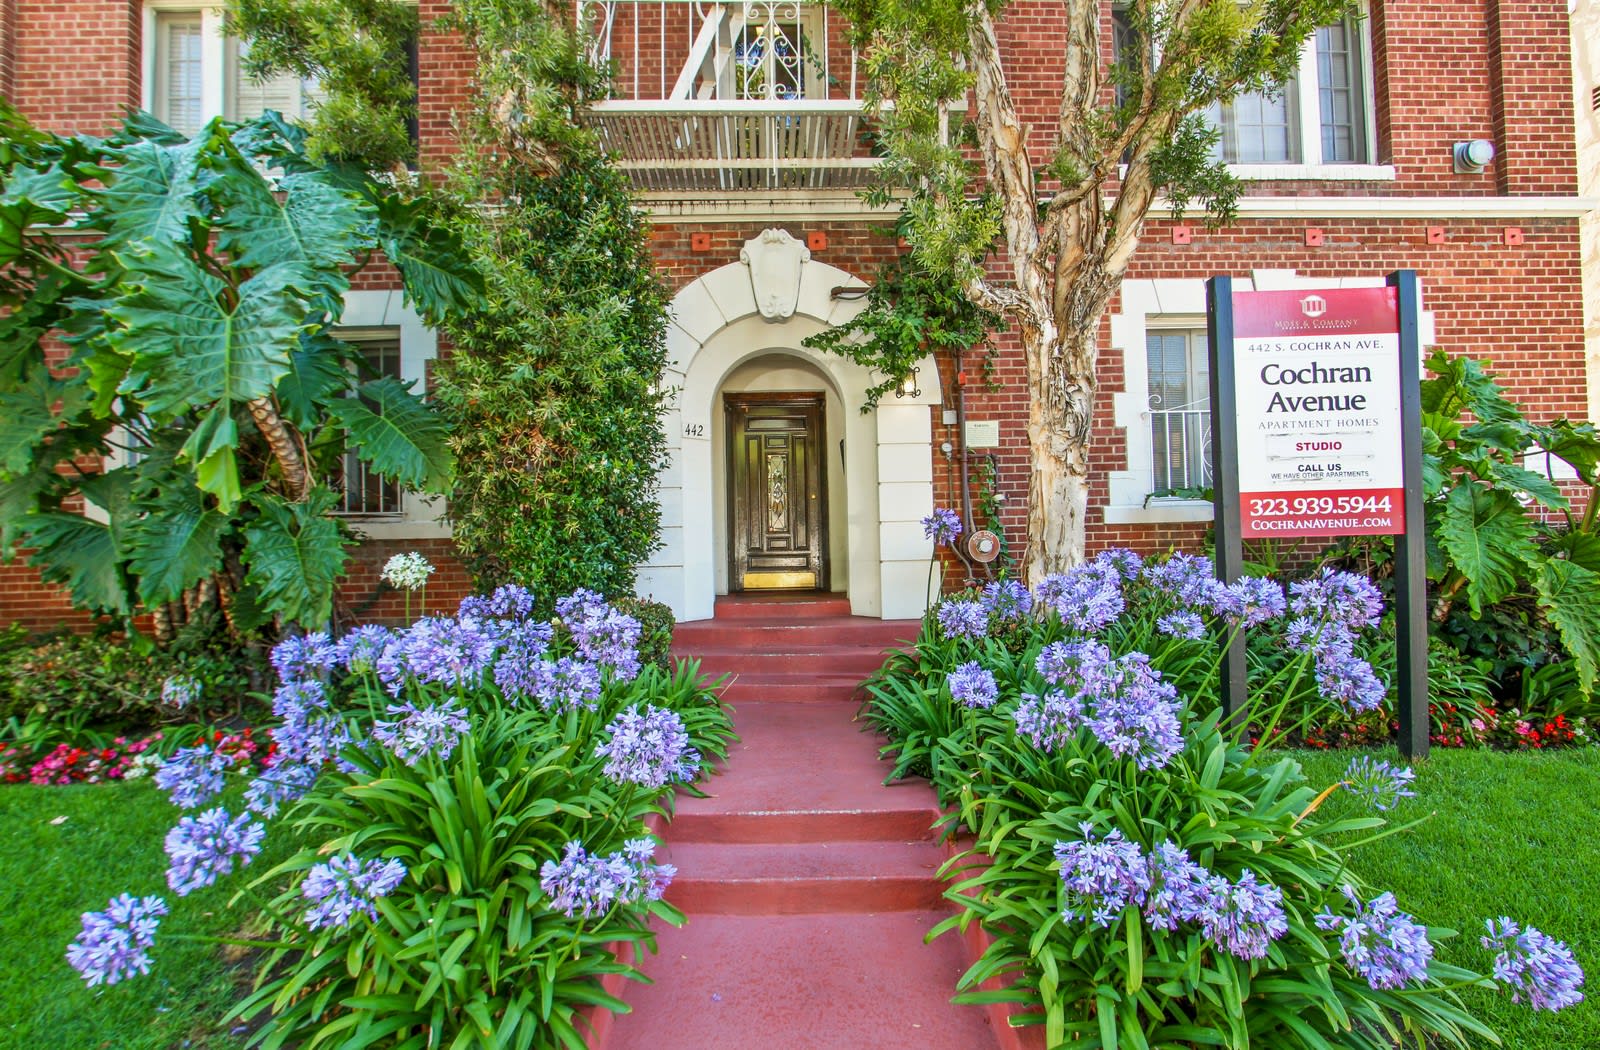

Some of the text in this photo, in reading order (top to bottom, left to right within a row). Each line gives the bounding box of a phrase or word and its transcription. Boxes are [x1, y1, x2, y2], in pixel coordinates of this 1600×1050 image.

[1313, 319, 1358, 327] COMPANY
[1248, 340, 1384, 352] 442 S. COCHRAN AVE.
[1260, 361, 1372, 385] Cochran
[1266, 391, 1366, 413] Avenue
[685, 423, 704, 436] 442
[1258, 418, 1379, 430] APARTMENT HOMES
[1295, 441, 1342, 451] STUDIO
[1297, 463, 1342, 472] CALL US
[1250, 495, 1392, 517] 323.939.5944
